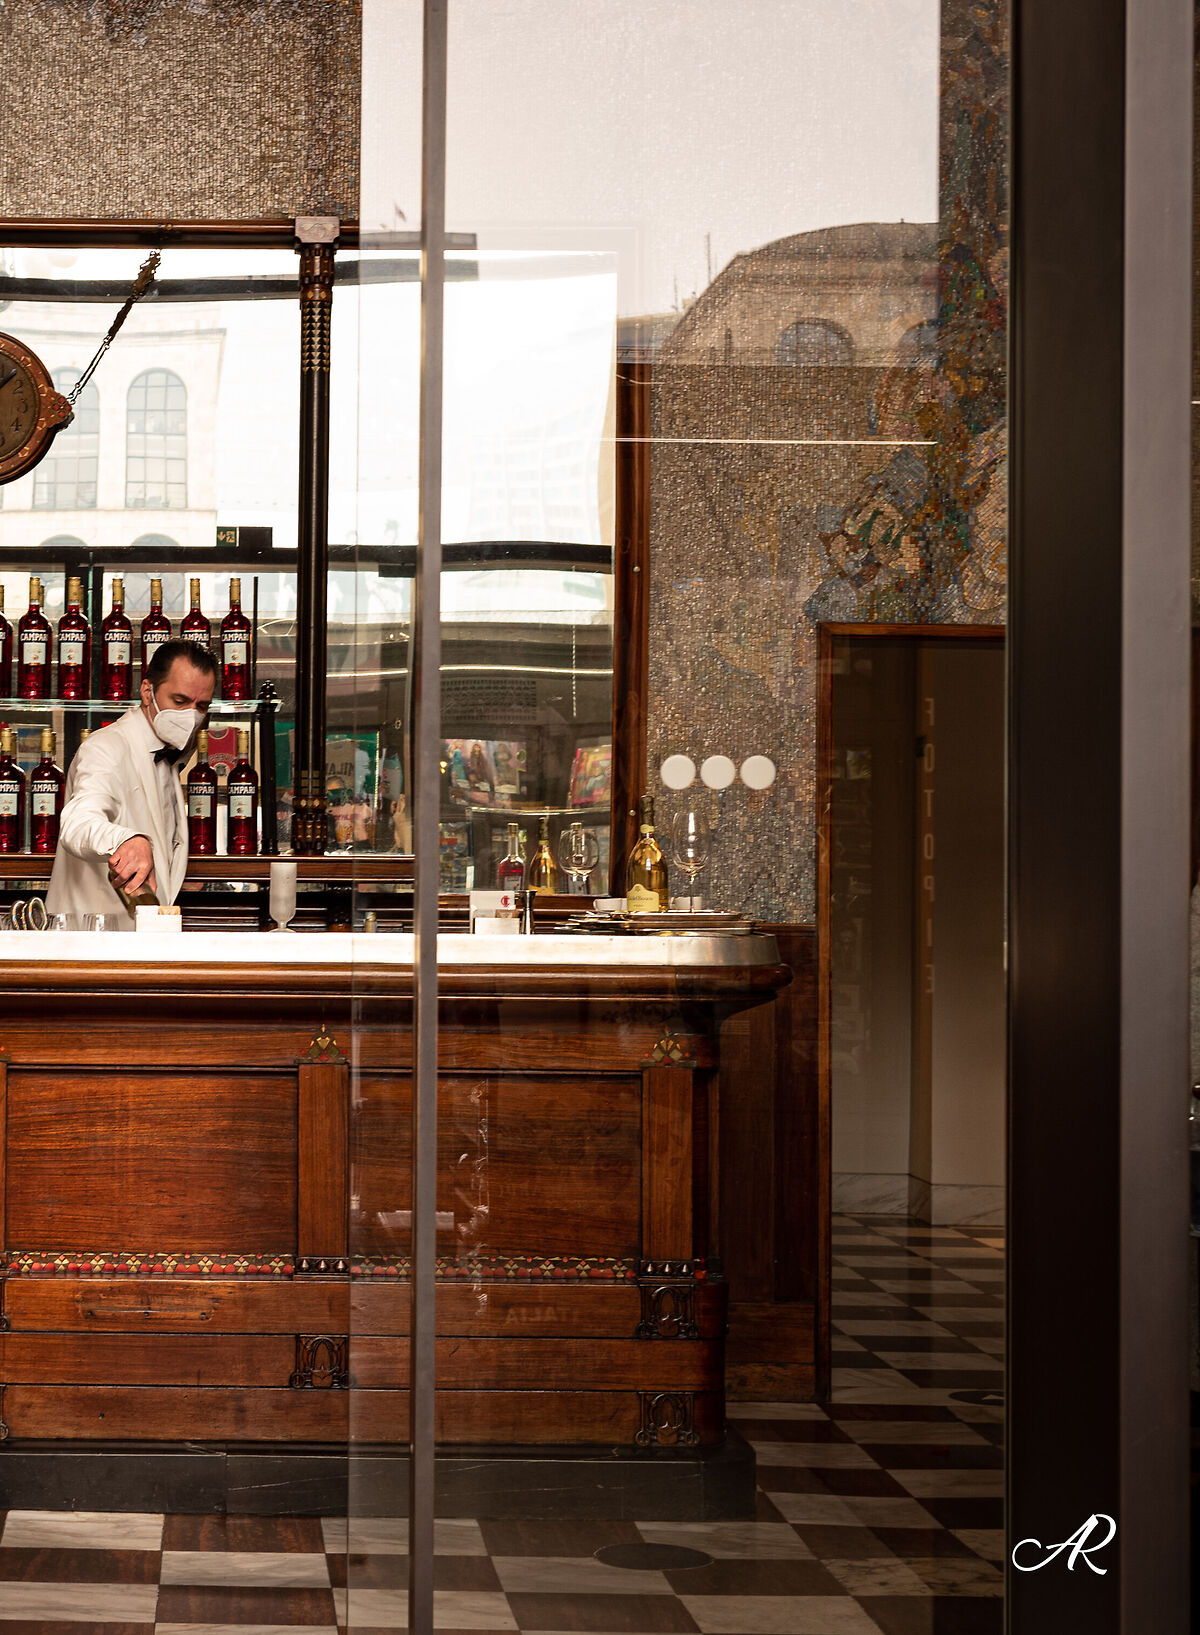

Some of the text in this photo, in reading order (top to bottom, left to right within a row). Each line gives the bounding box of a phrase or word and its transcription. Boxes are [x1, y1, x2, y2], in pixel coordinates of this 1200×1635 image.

[12, 380, 24, 394] 2
[10, 417, 22, 432] 4
[105, 632, 132, 642] CAMPAR
[142, 633, 170, 643] CAMPAR
